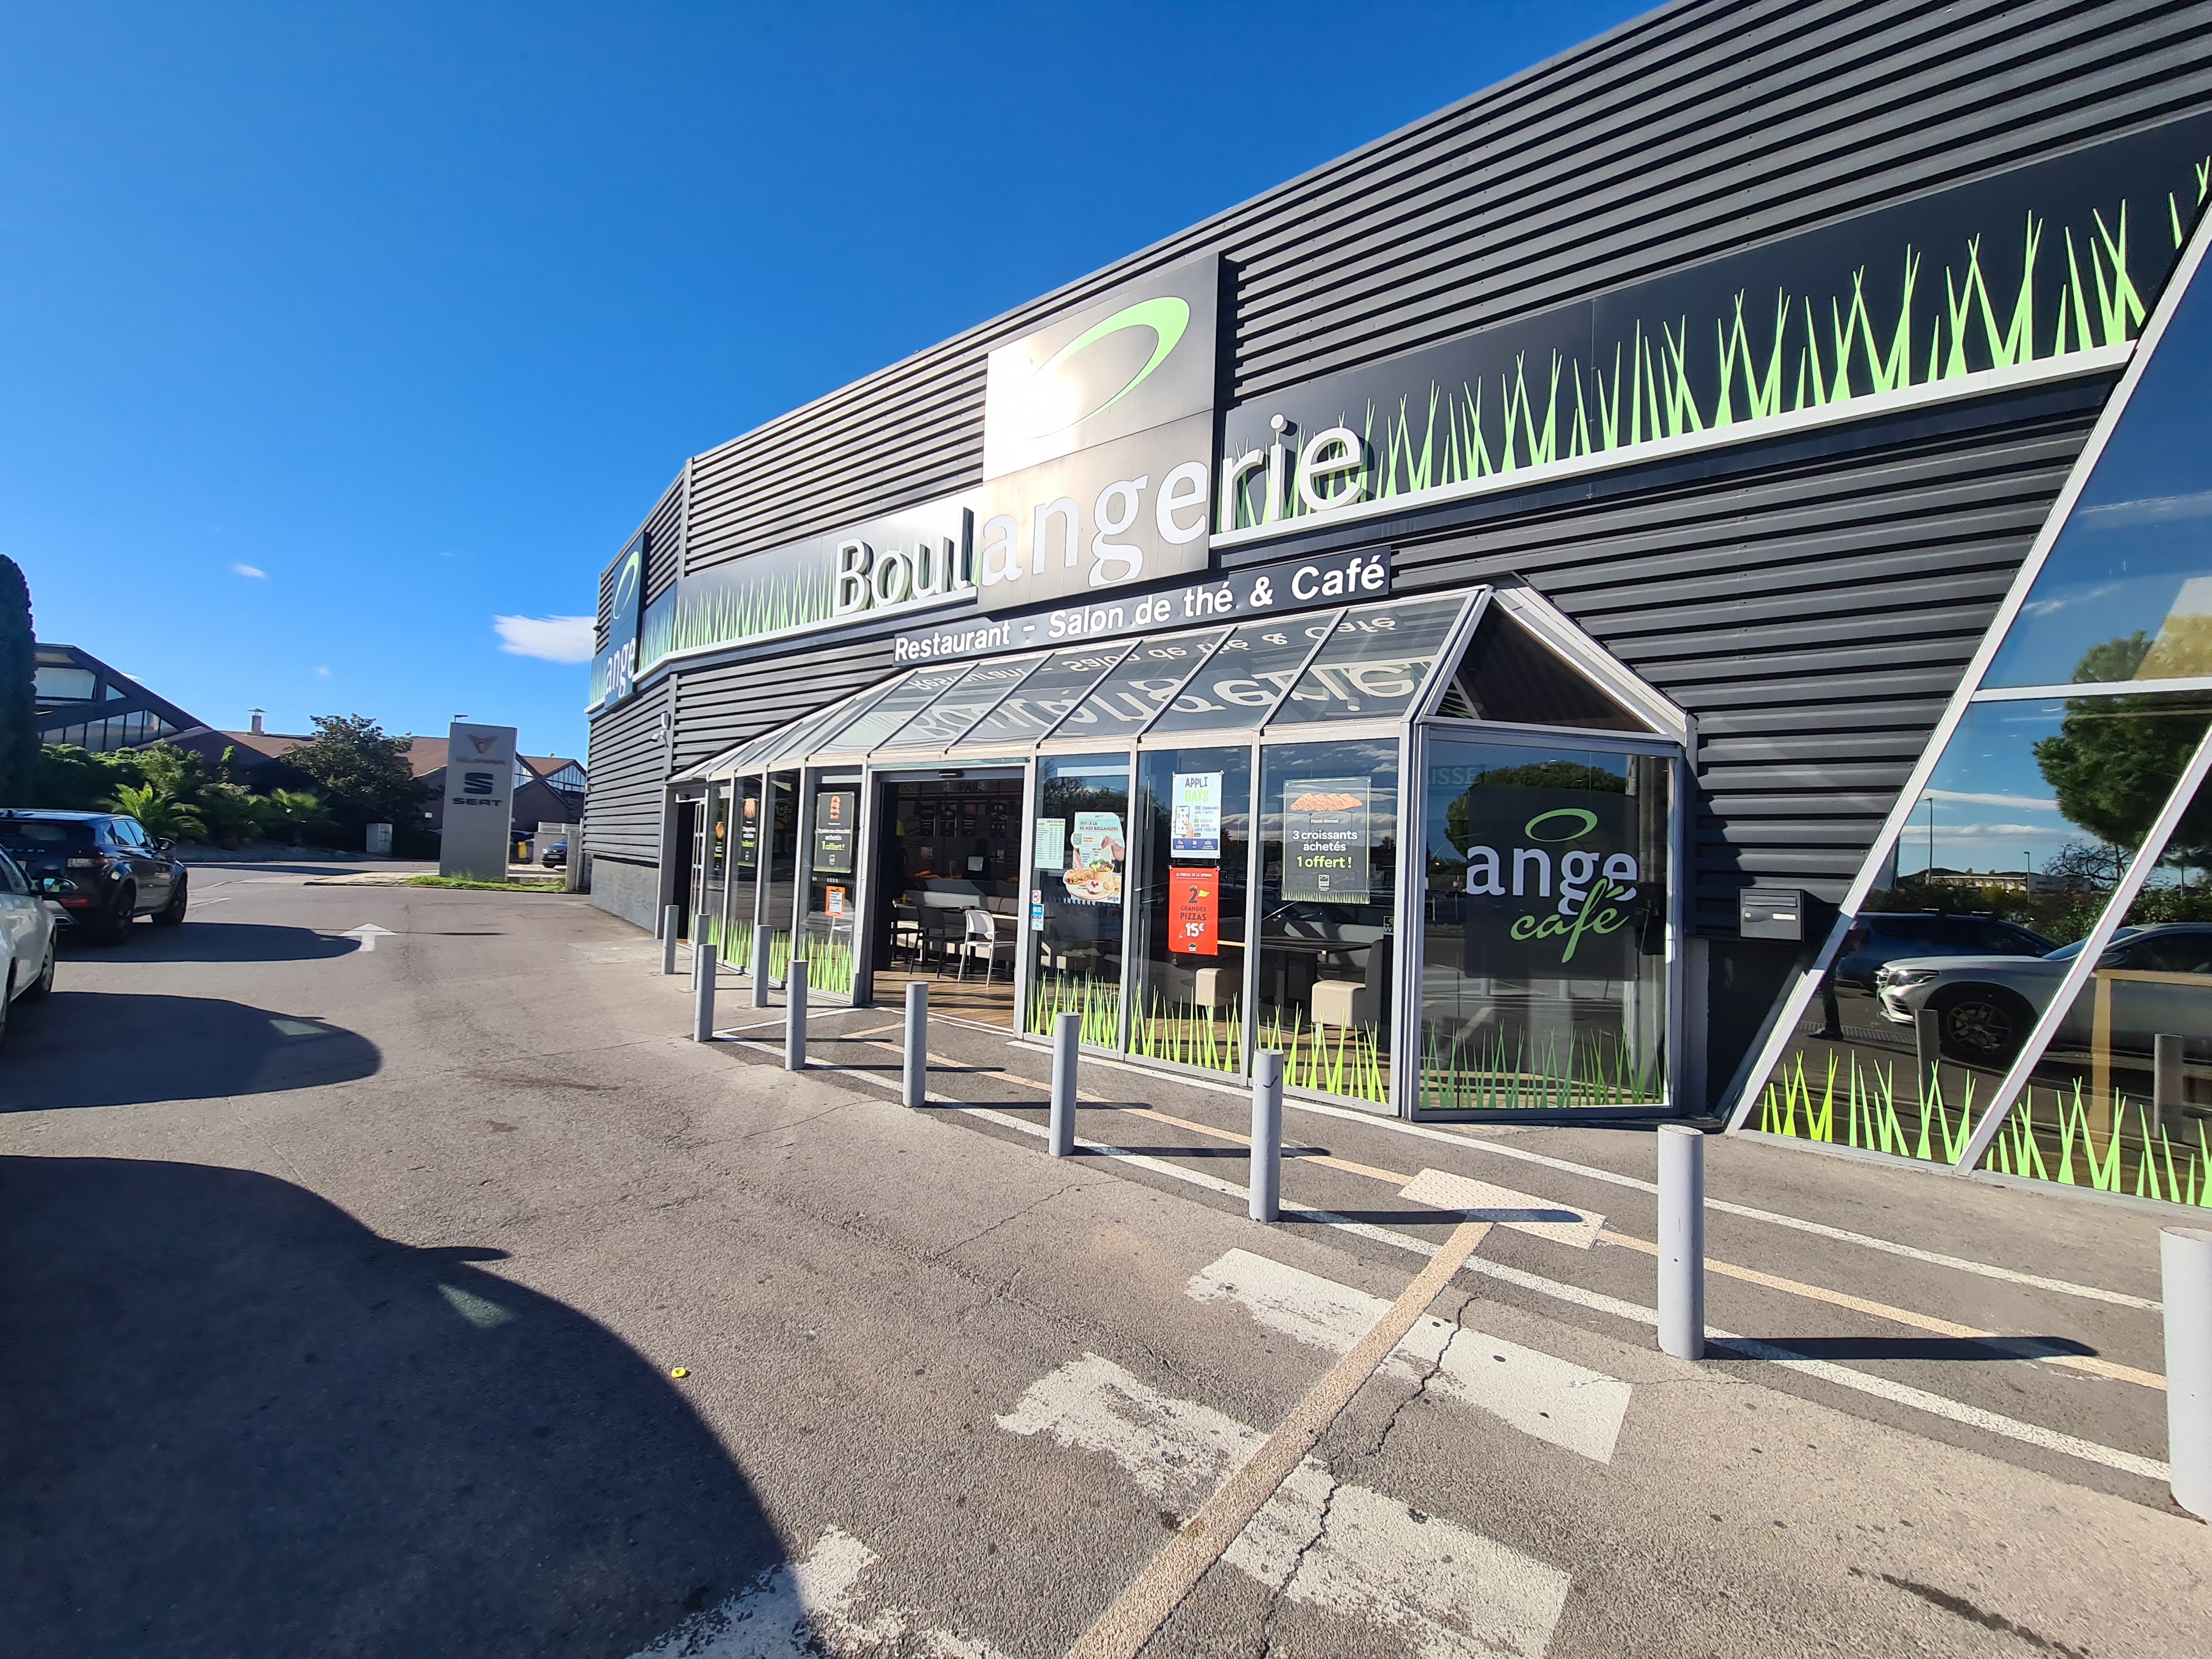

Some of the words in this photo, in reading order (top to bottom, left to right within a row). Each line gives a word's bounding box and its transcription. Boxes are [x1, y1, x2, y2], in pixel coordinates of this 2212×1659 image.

[894, 620, 1011, 662] Restaurant
[1048, 606, 1124, 638] Salon
[1135, 594, 1171, 625] de
[1184, 580, 1234, 617] thé
[1249, 576, 1274, 607] &
[1291, 554, 1386, 600] Café
[606, 637, 636, 698] ange
[1185, 776, 1208, 788] APPLI
[452, 797, 503, 807] SEAT
[1185, 789, 1209, 803] DAYS
[1292, 830, 1300, 840] 3
[1301, 830, 1358, 840] croissants
[1303, 841, 1347, 852] achetés
[1296, 855, 1303, 868] 1
[1305, 855, 1345, 868] offert
[1347, 856, 1353, 868] !
[1465, 845, 1637, 915] ange
[1188, 888, 1198, 904] 2
[1180, 912, 1207, 921] PIZZAS
[1510, 878, 1629, 963] café
[1185, 922, 1204, 937] 15€
